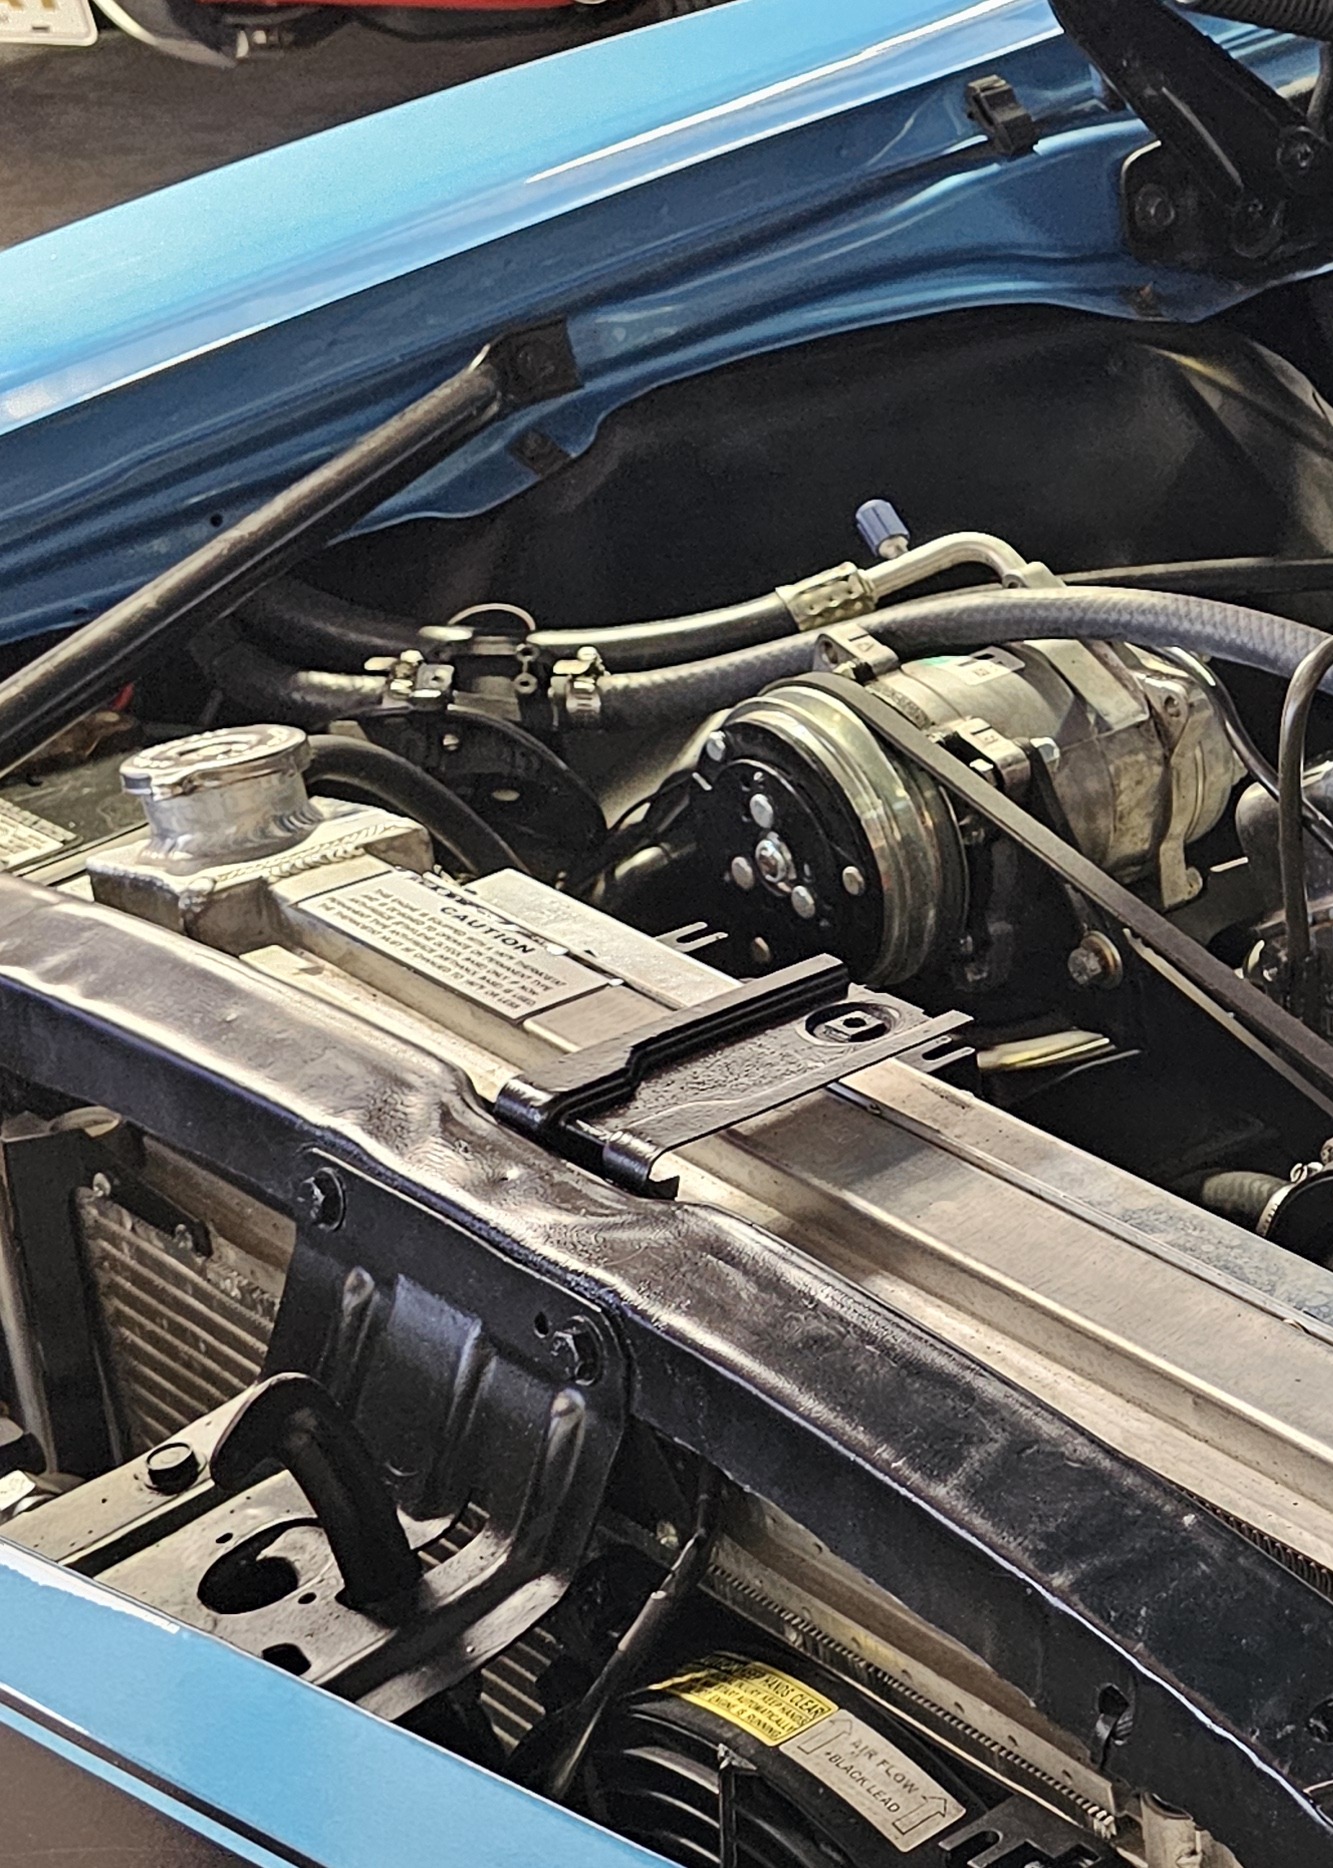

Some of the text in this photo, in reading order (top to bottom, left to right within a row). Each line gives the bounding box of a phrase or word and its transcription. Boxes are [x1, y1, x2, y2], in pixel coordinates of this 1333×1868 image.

[439, 906, 535, 953] CAUTION
[764, 1673, 795, 1698] HANDS
[789, 1693, 826, 1720] CLEAR
[851, 1739, 919, 1793] AIR FLOW
[865, 1785, 901, 1812] LEAD
